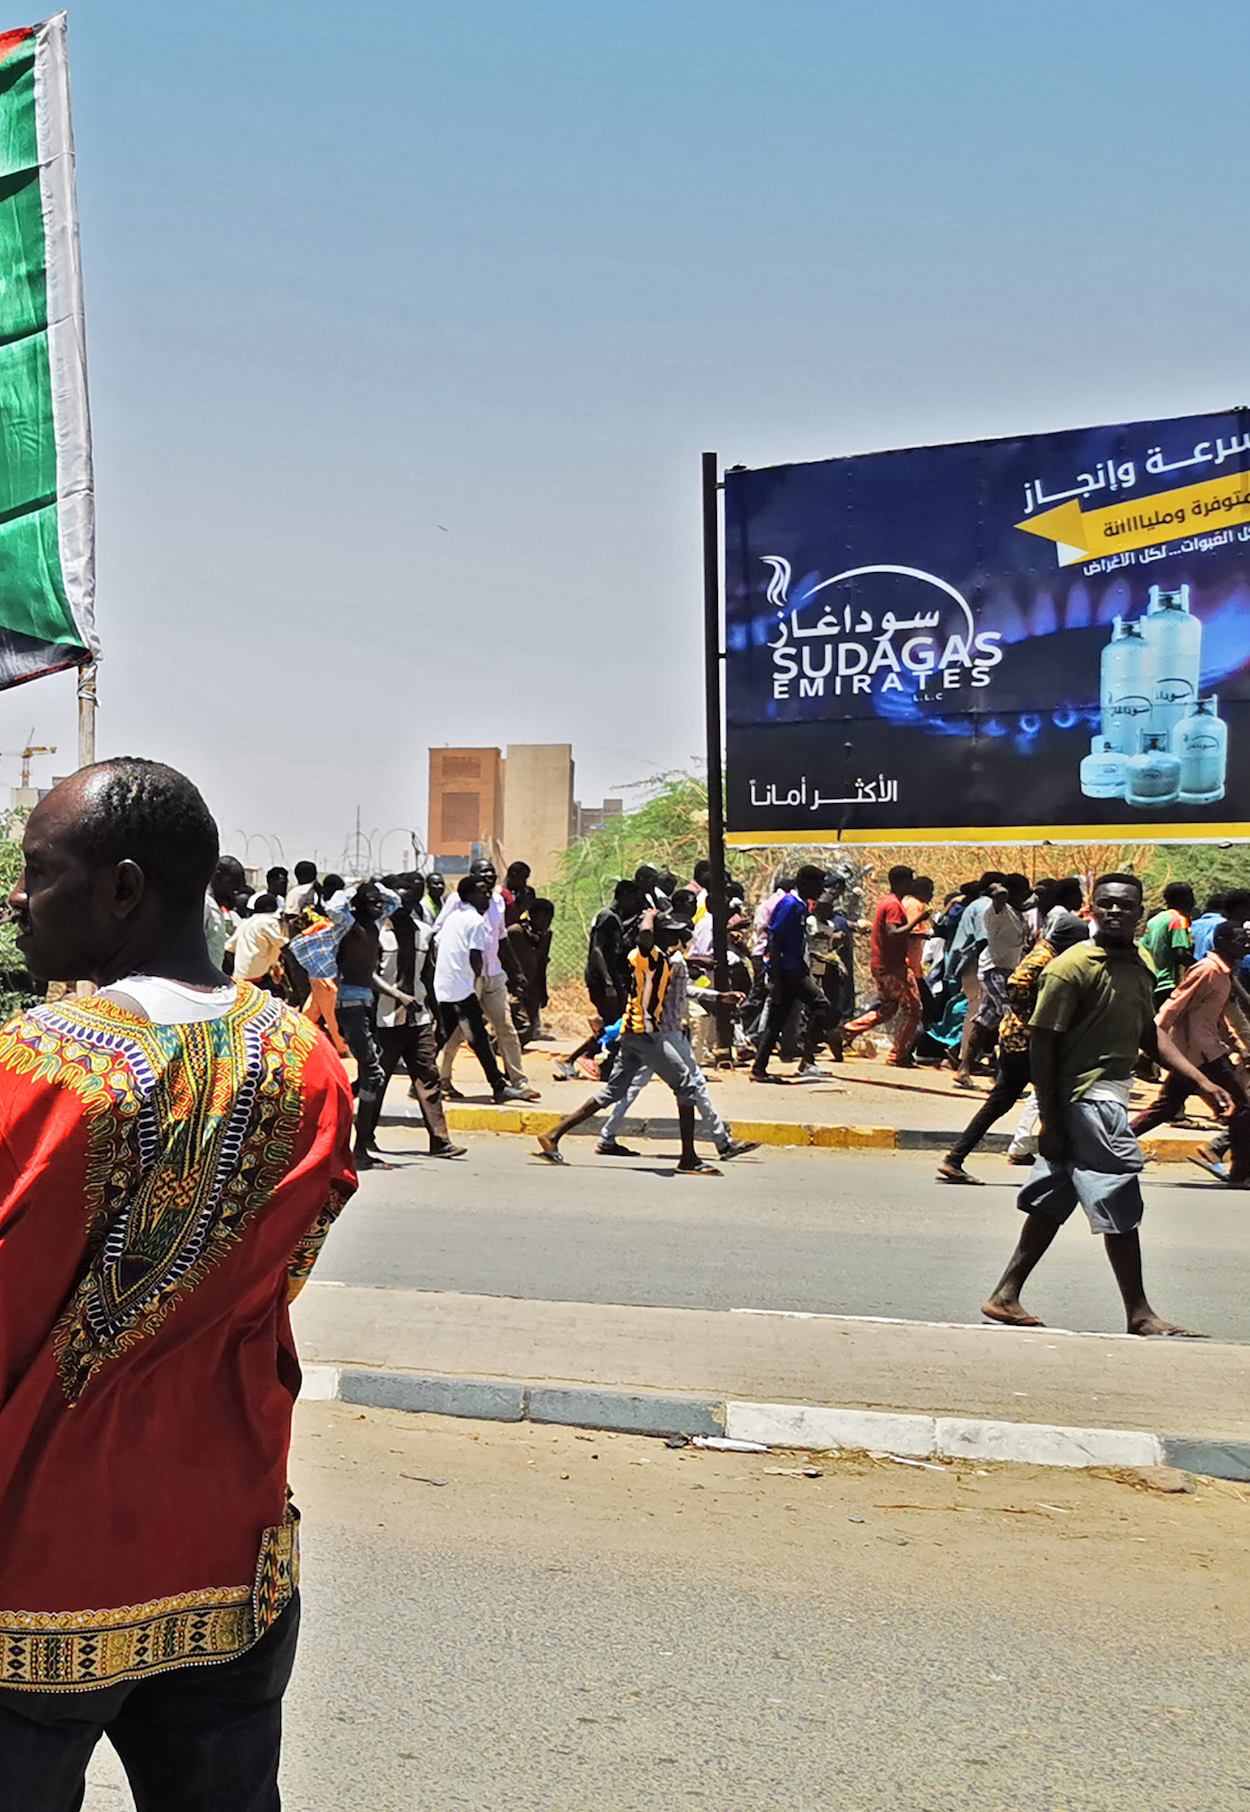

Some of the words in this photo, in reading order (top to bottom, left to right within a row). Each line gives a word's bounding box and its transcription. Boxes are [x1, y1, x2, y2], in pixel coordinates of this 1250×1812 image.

[766, 603, 940, 649] سوداغاز
[772, 631, 1003, 681] SUDAGAS
[773, 666, 991, 699] EMIRATES
[809, 773, 898, 811] الأكثر
